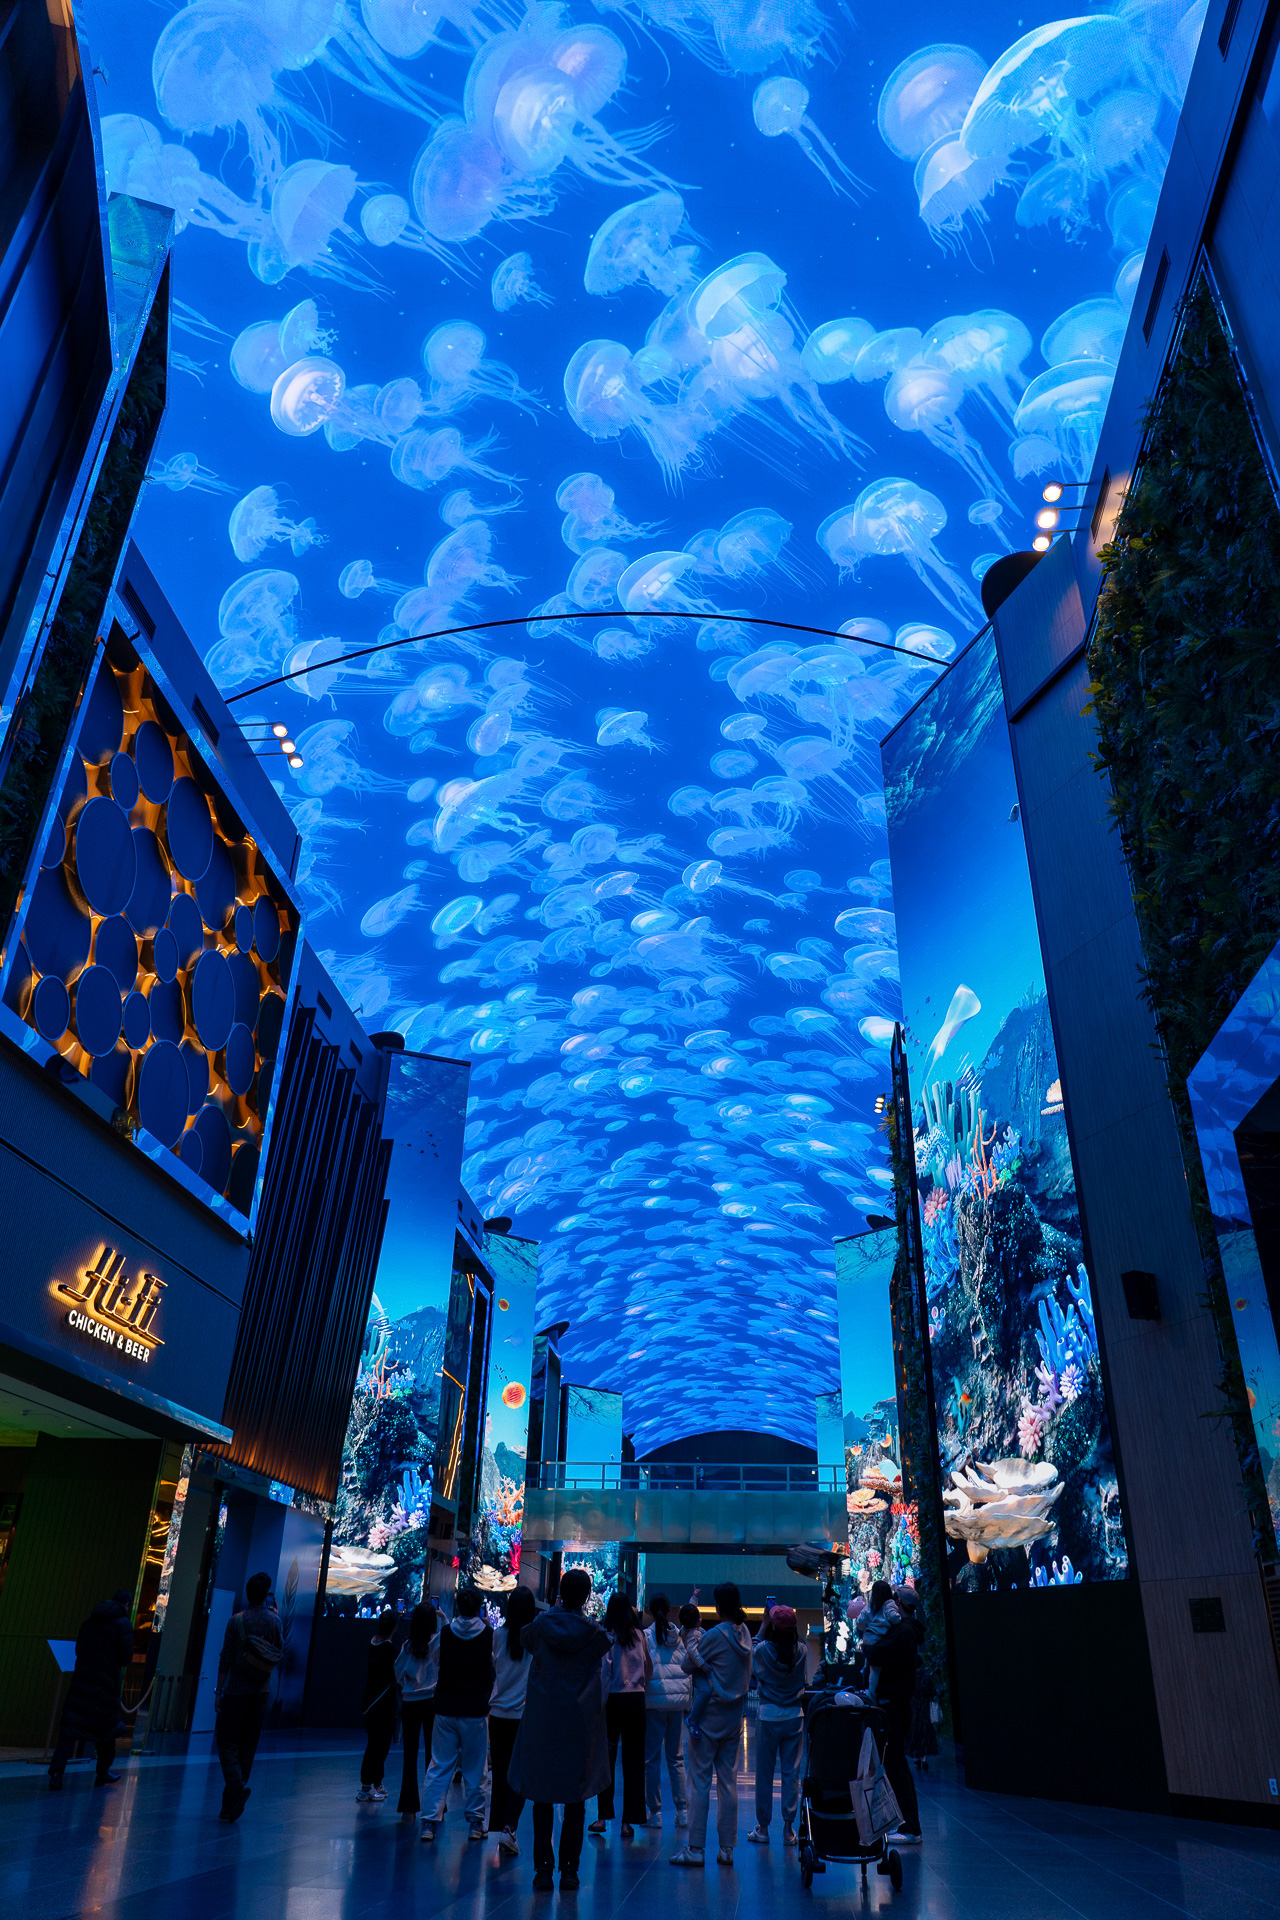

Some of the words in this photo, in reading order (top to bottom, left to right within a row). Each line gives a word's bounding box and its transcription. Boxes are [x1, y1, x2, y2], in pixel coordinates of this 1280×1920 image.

[68, 1310, 115, 1345] CHICKEN
[116, 1334, 124, 1349] &
[125, 1339, 150, 1363] BEER
